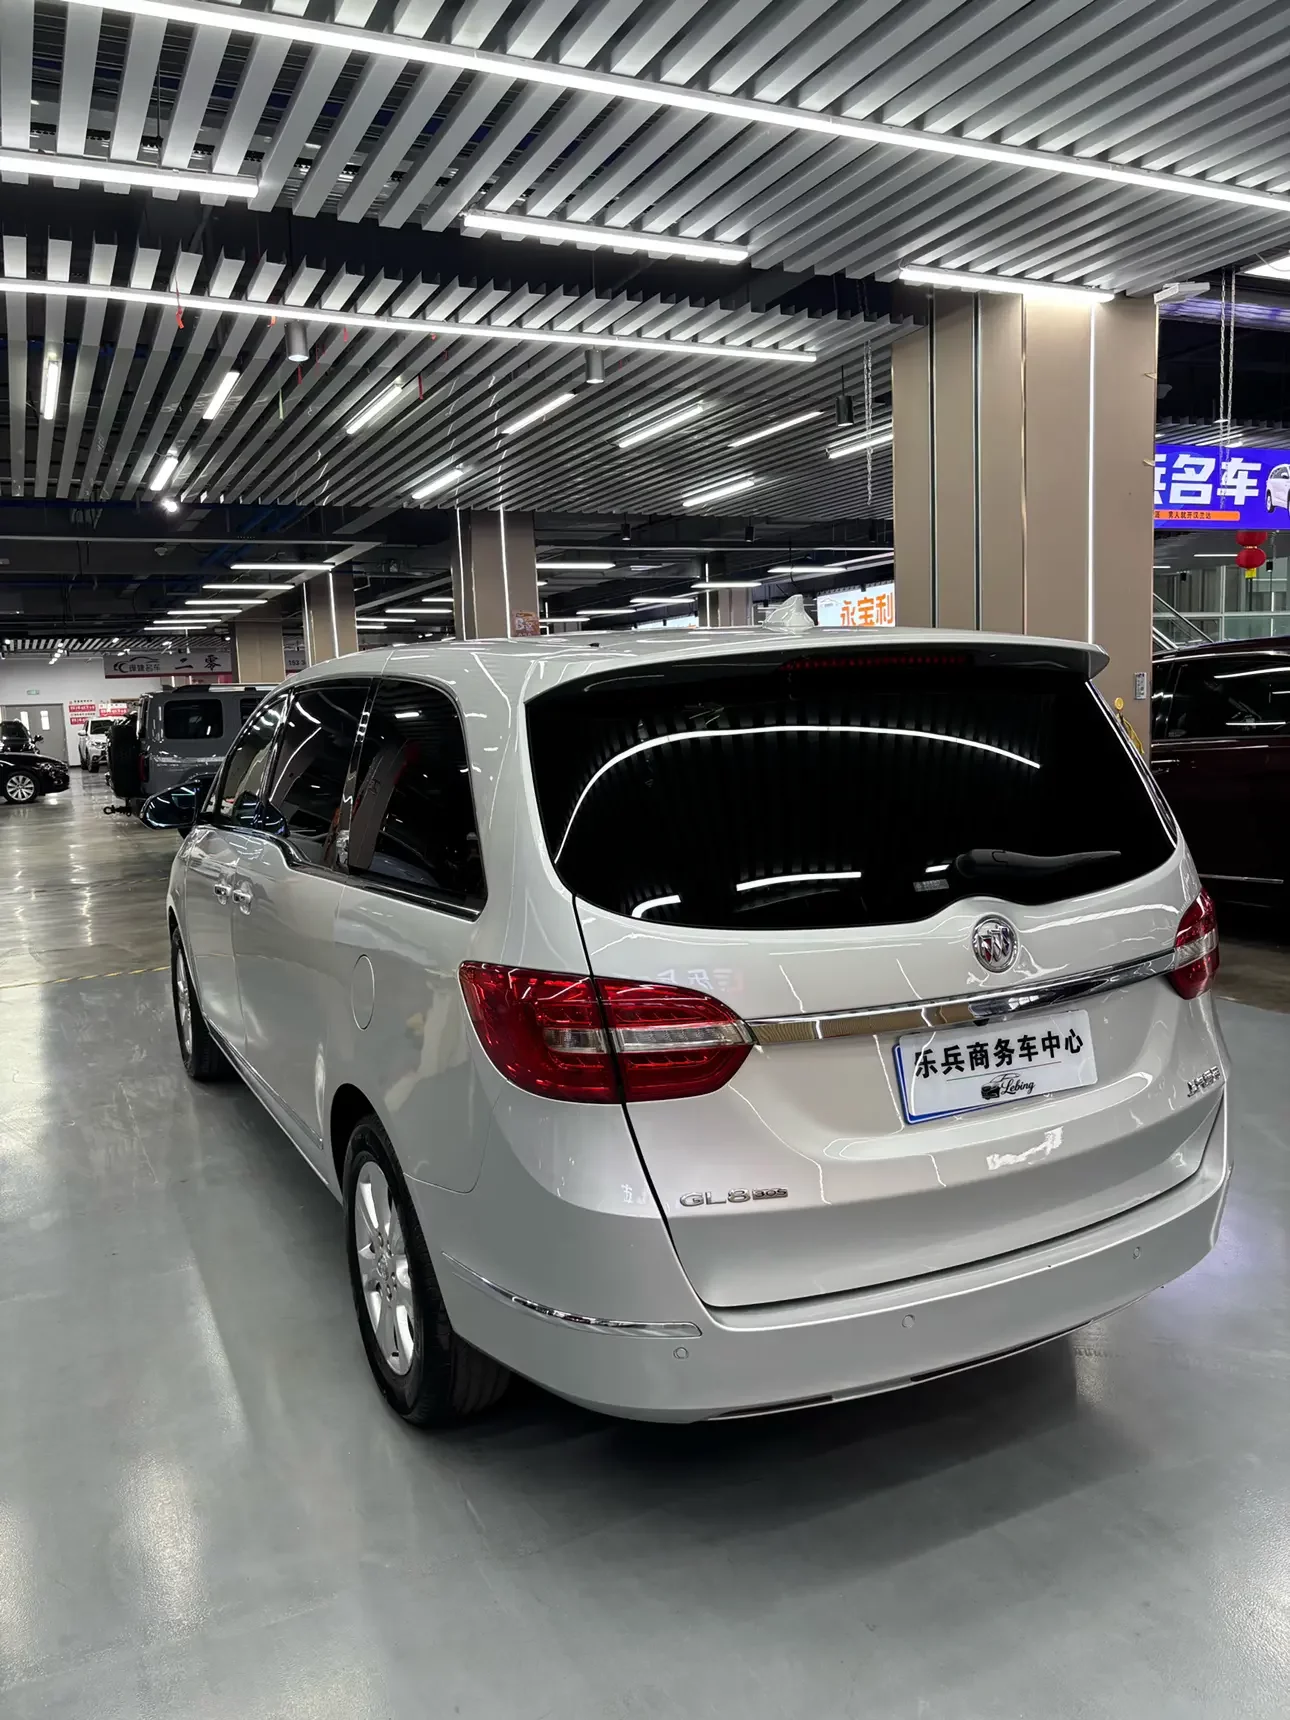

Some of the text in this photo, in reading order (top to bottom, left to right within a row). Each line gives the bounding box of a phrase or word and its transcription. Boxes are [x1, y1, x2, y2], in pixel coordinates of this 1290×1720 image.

[840, 592, 894, 627] 永宝利
[914, 1029, 1084, 1078] 乐兵商务车中心
[1000, 1078, 1036, 1095] Lebing
[679, 1188, 751, 1207] GL8
